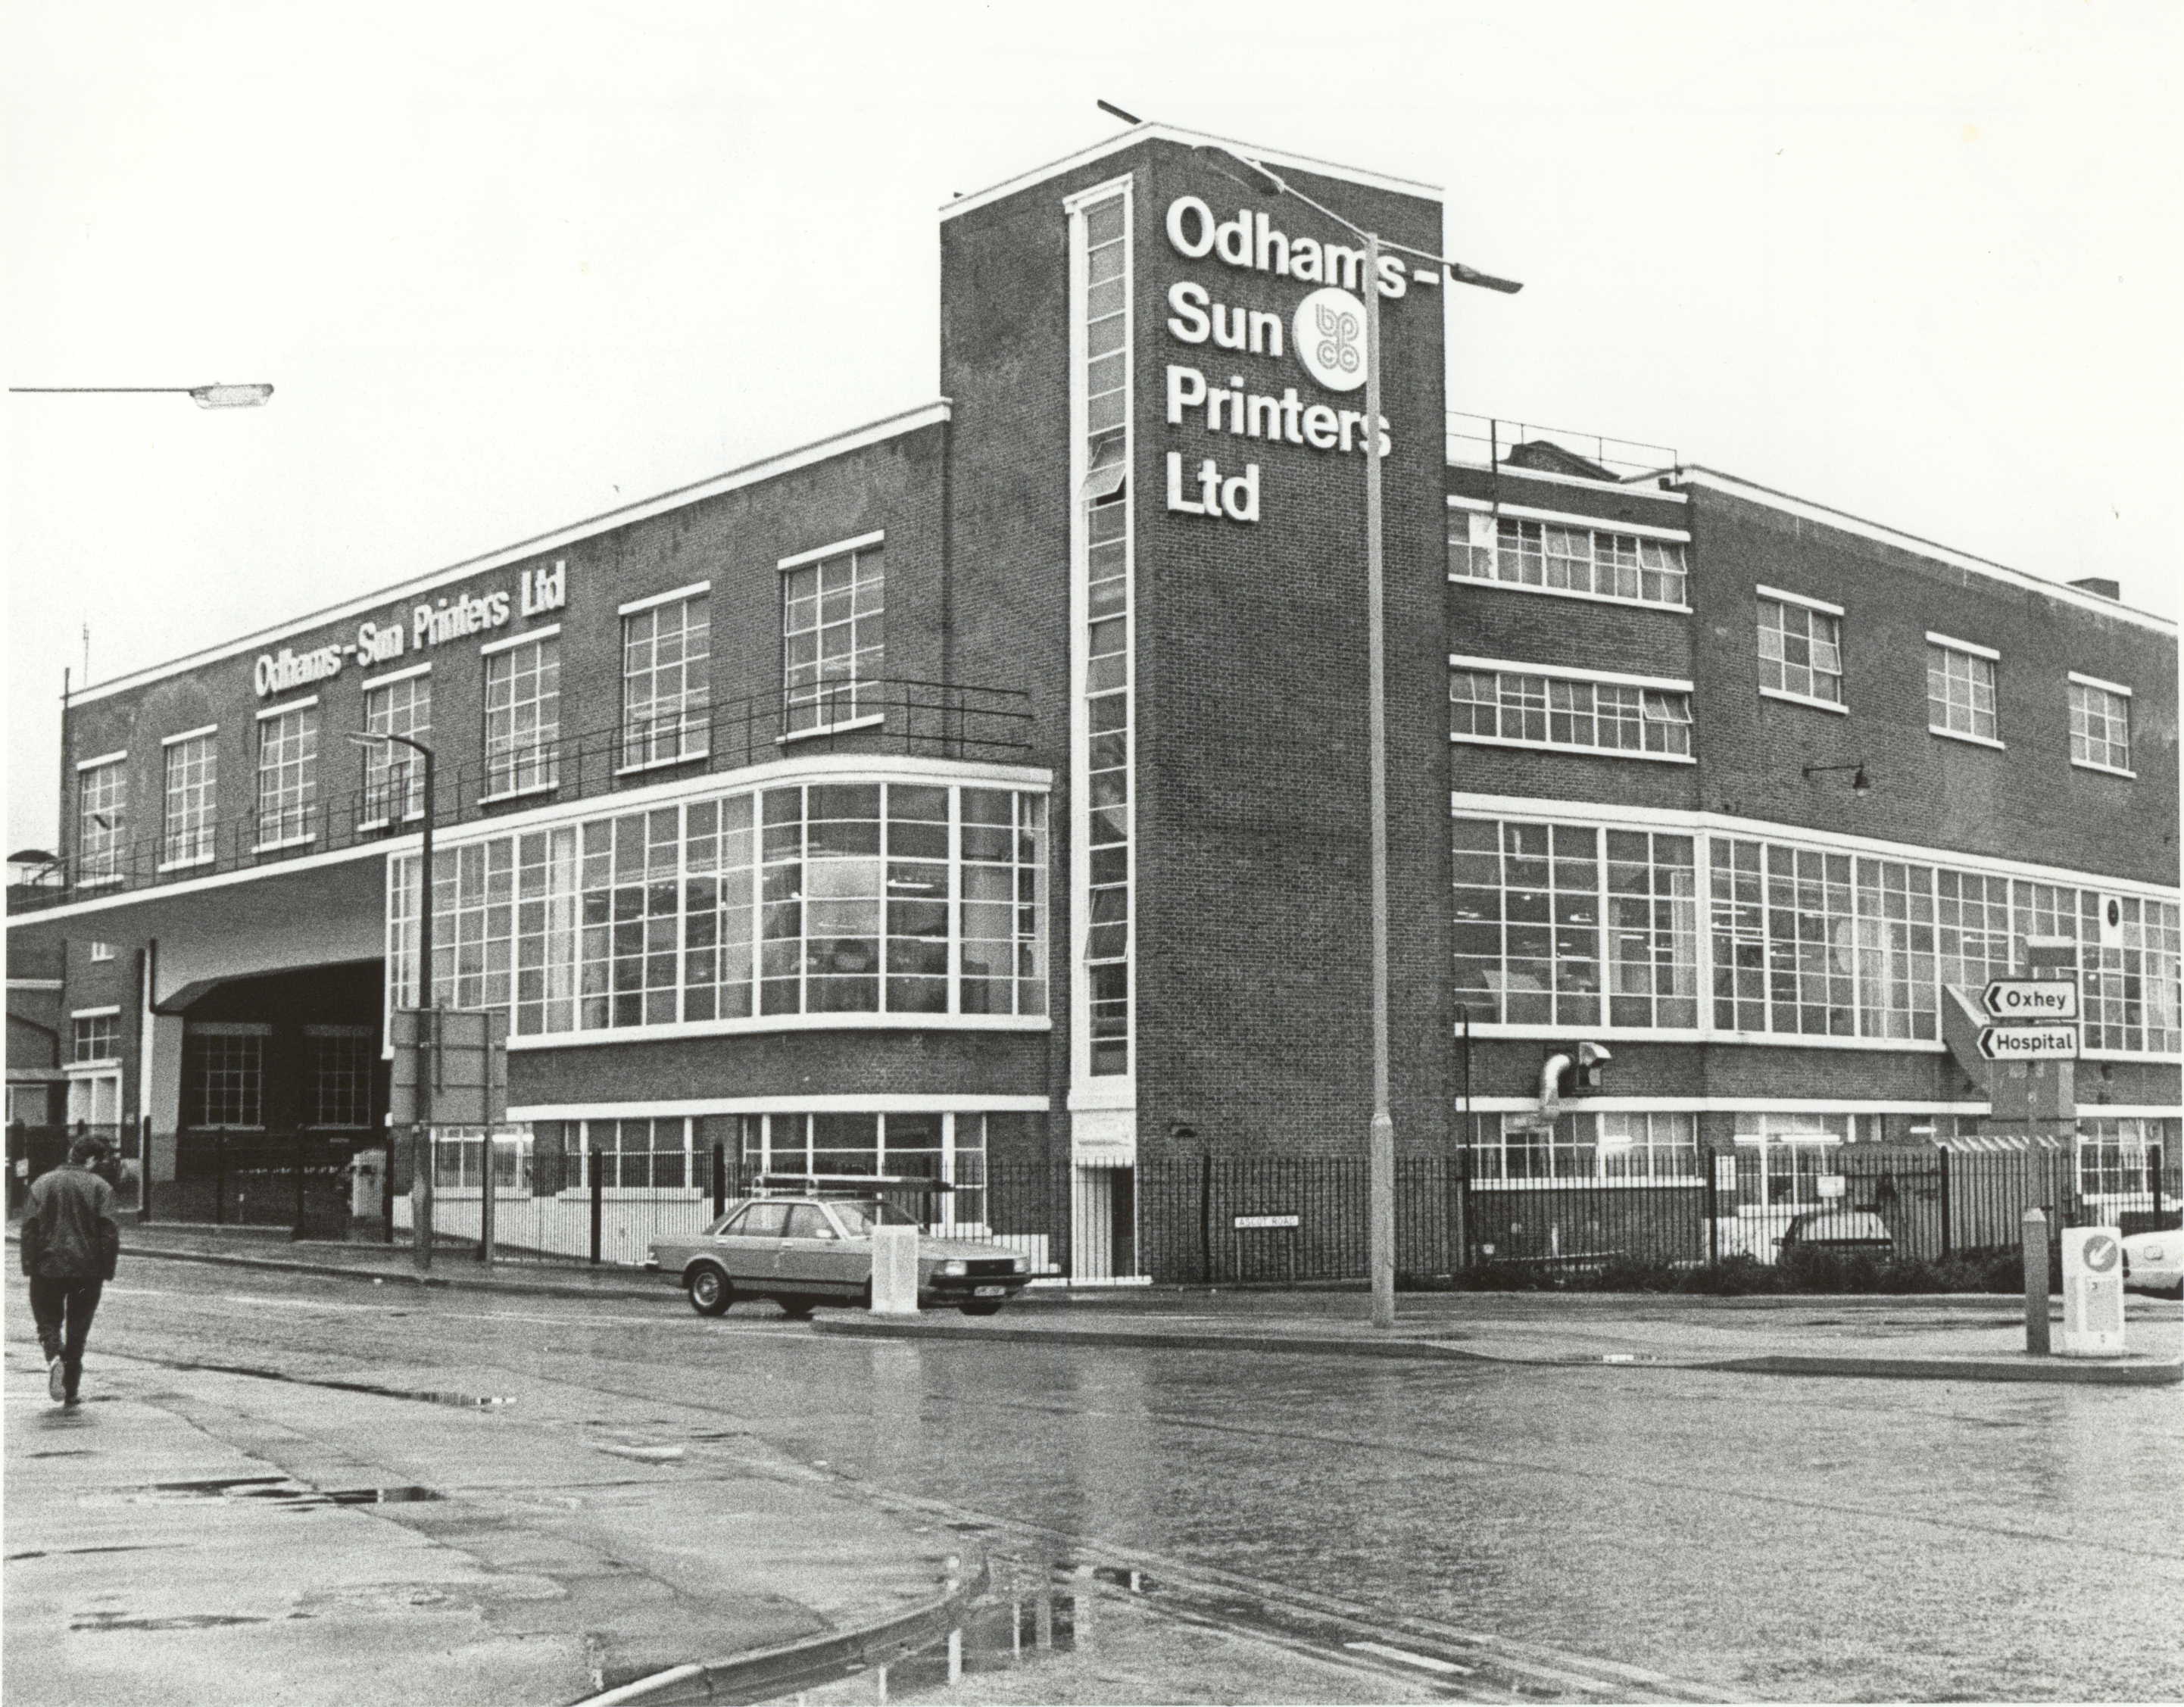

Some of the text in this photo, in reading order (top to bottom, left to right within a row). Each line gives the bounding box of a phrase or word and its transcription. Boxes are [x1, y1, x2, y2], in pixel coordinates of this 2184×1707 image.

[1166, 195, 1440, 299] Odhams-
[1167, 281, 1283, 357] Sun
[1167, 364, 1392, 457] Printers
[1167, 451, 1259, 523] Ltd
[357, 622, 404, 667] Sun
[413, 591, 510, 650] Printers
[521, 560, 566, 617] Ltd
[2006, 990, 2066, 1010] Oxhey
[1996, 1033, 2073, 1052] Hospital
